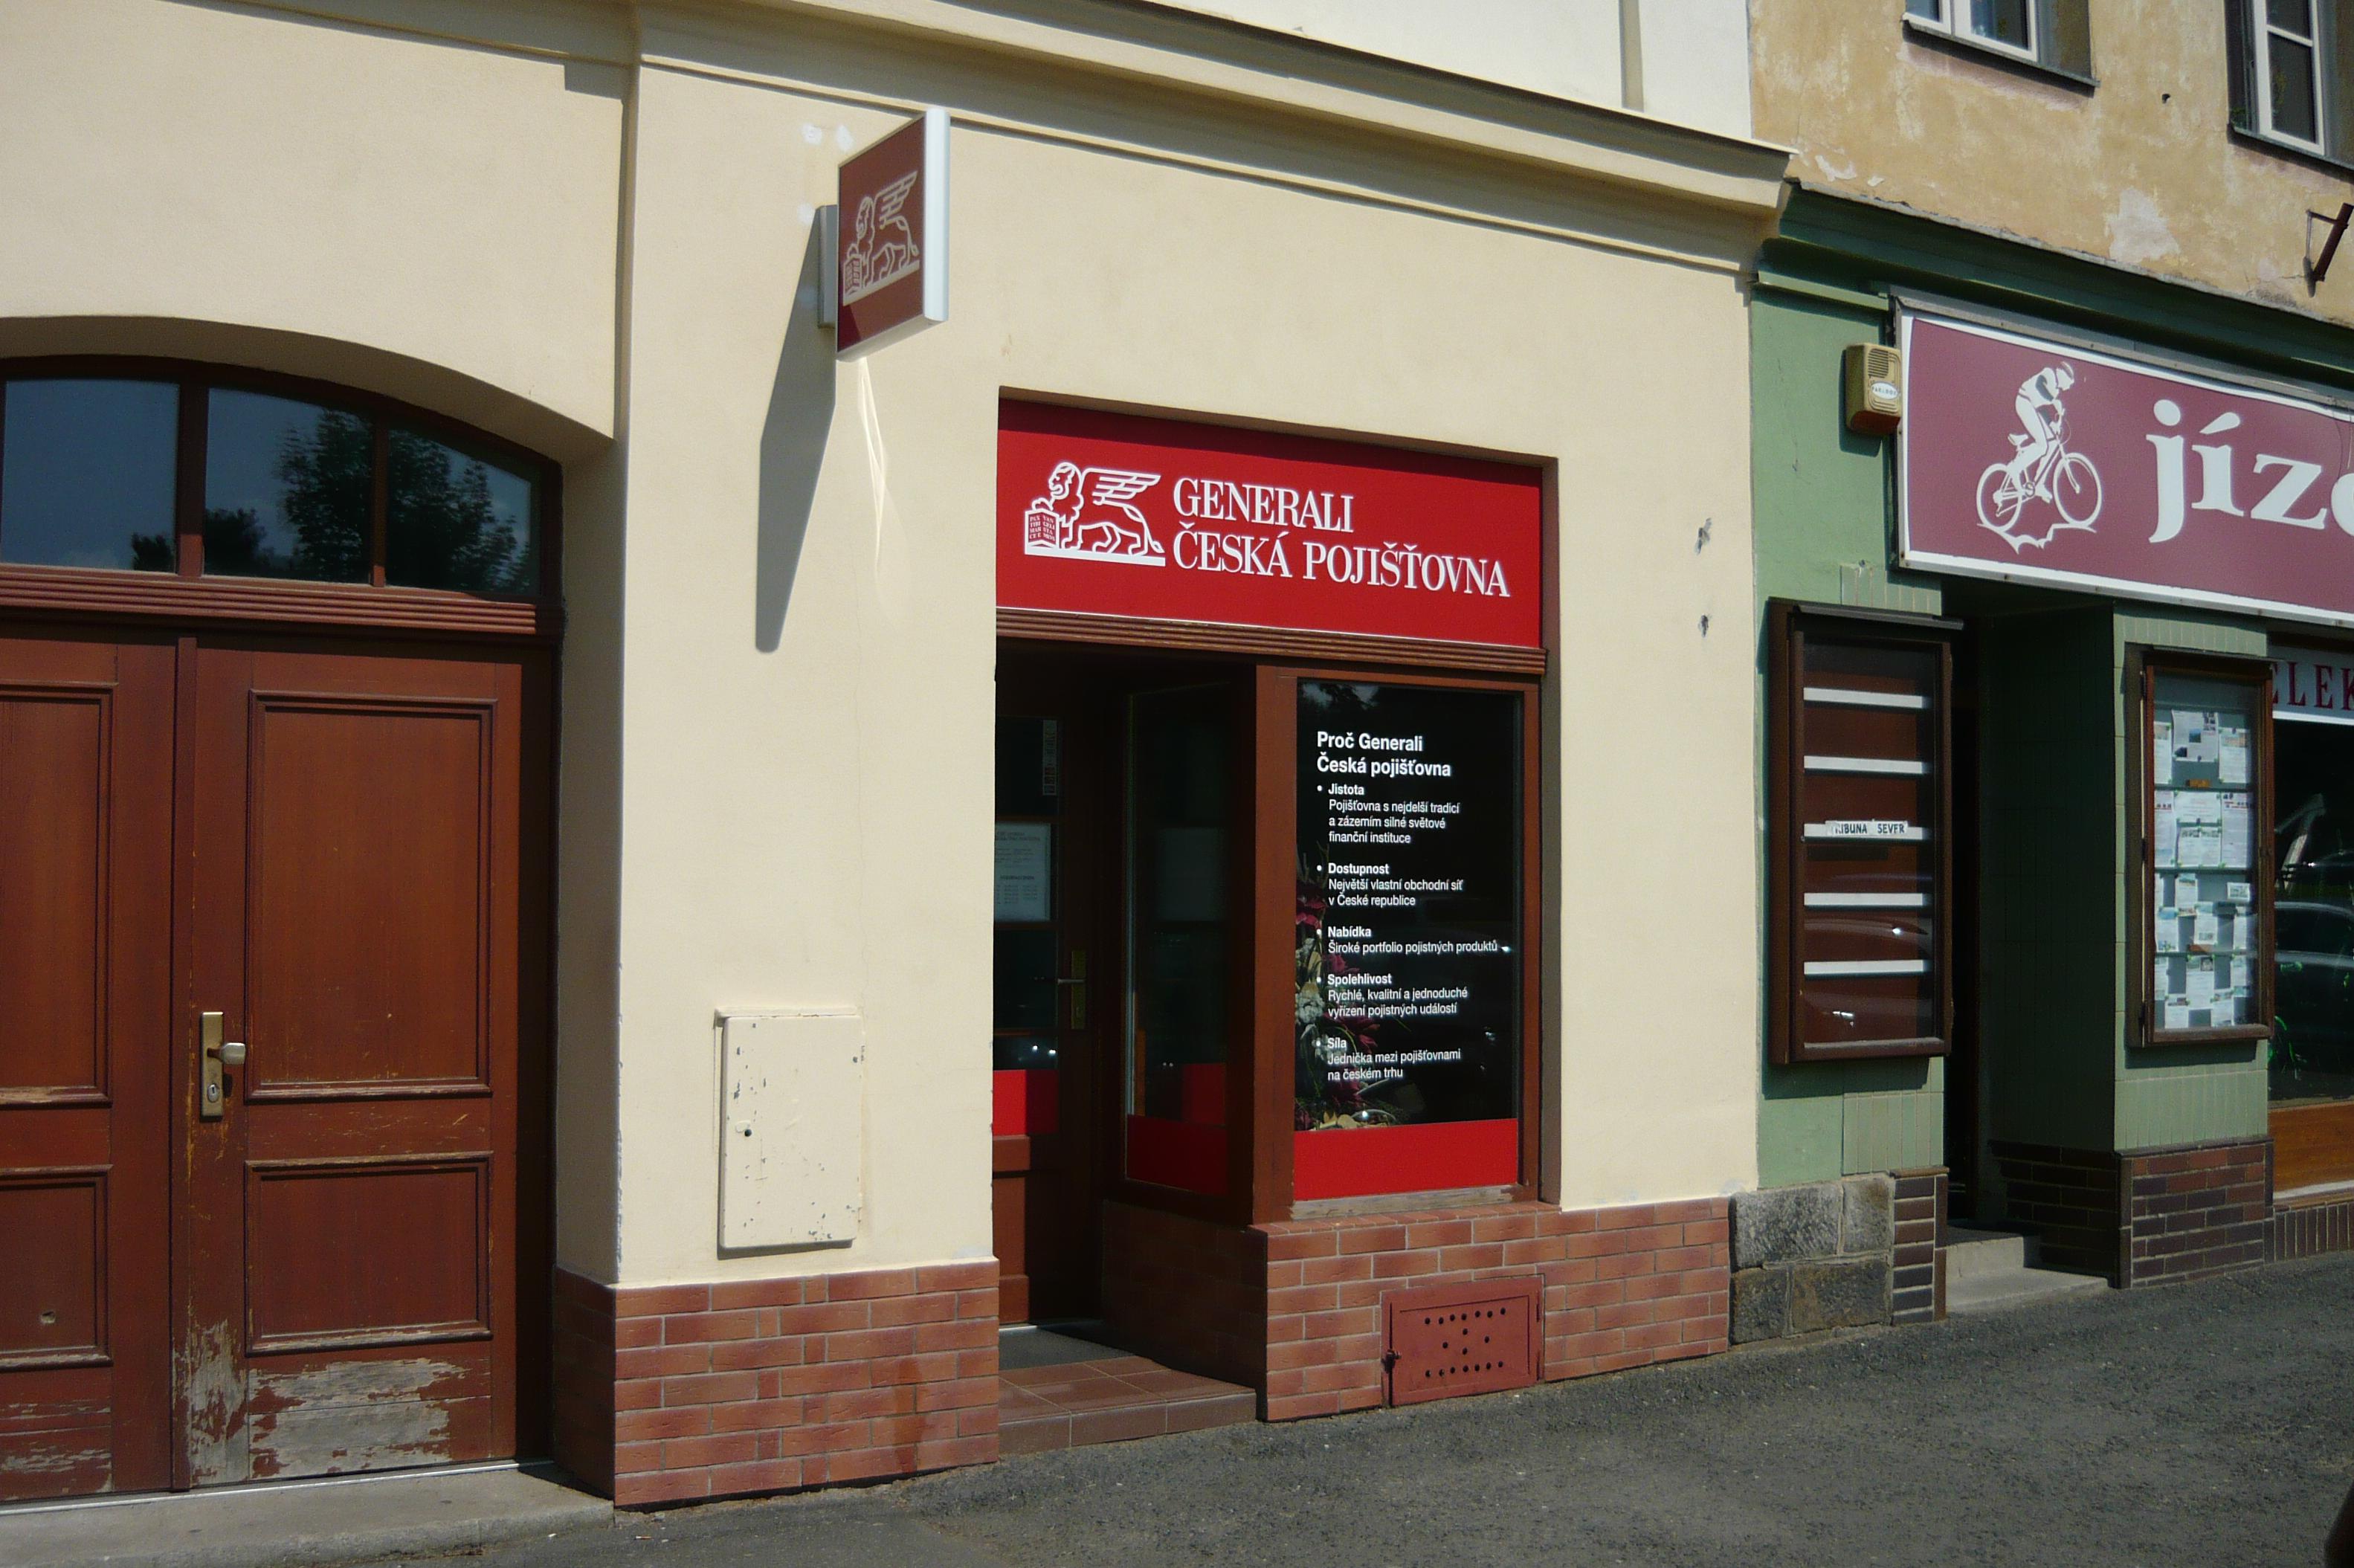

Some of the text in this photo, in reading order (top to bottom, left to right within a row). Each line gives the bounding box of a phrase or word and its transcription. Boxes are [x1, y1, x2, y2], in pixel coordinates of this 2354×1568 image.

[1173, 478, 1354, 533] GENERALI
[1173, 522, 1510, 597] ČESKÁ POJIŠŤOVNA
[1317, 732, 1423, 752] Proč Generali
[1317, 752, 1451, 777] Česká pojišťovna
[1328, 783, 1364, 796] Jistota
[1329, 799, 1460, 814] Pojišťovna s nejdelší tradicí
[1329, 816, 1445, 829] a zázemím silné světové
[1329, 831, 1411, 844] finanční instituce
[1328, 862, 1390, 876] Dostupnost
[1329, 878, 1463, 891] Největší vlastní obchodní síť
[1328, 892, 1416, 908] v České republice
[1328, 926, 1371, 938] Nabídka
[1328, 939, 1497, 955] Široké portfolio pojistných produktů
[1327, 973, 1392, 987] Spolehlivost
[1328, 986, 1468, 1001] Rychlé, kvalitní a jednoduché
[1328, 1002, 1457, 1019] vyřízení pojistných událostí
[1327, 1037, 1347, 1048] Síla
[1328, 1048, 1460, 1065] Jednička mezi pojišťovnami
[1328, 1068, 1403, 1081] na českém trhu
